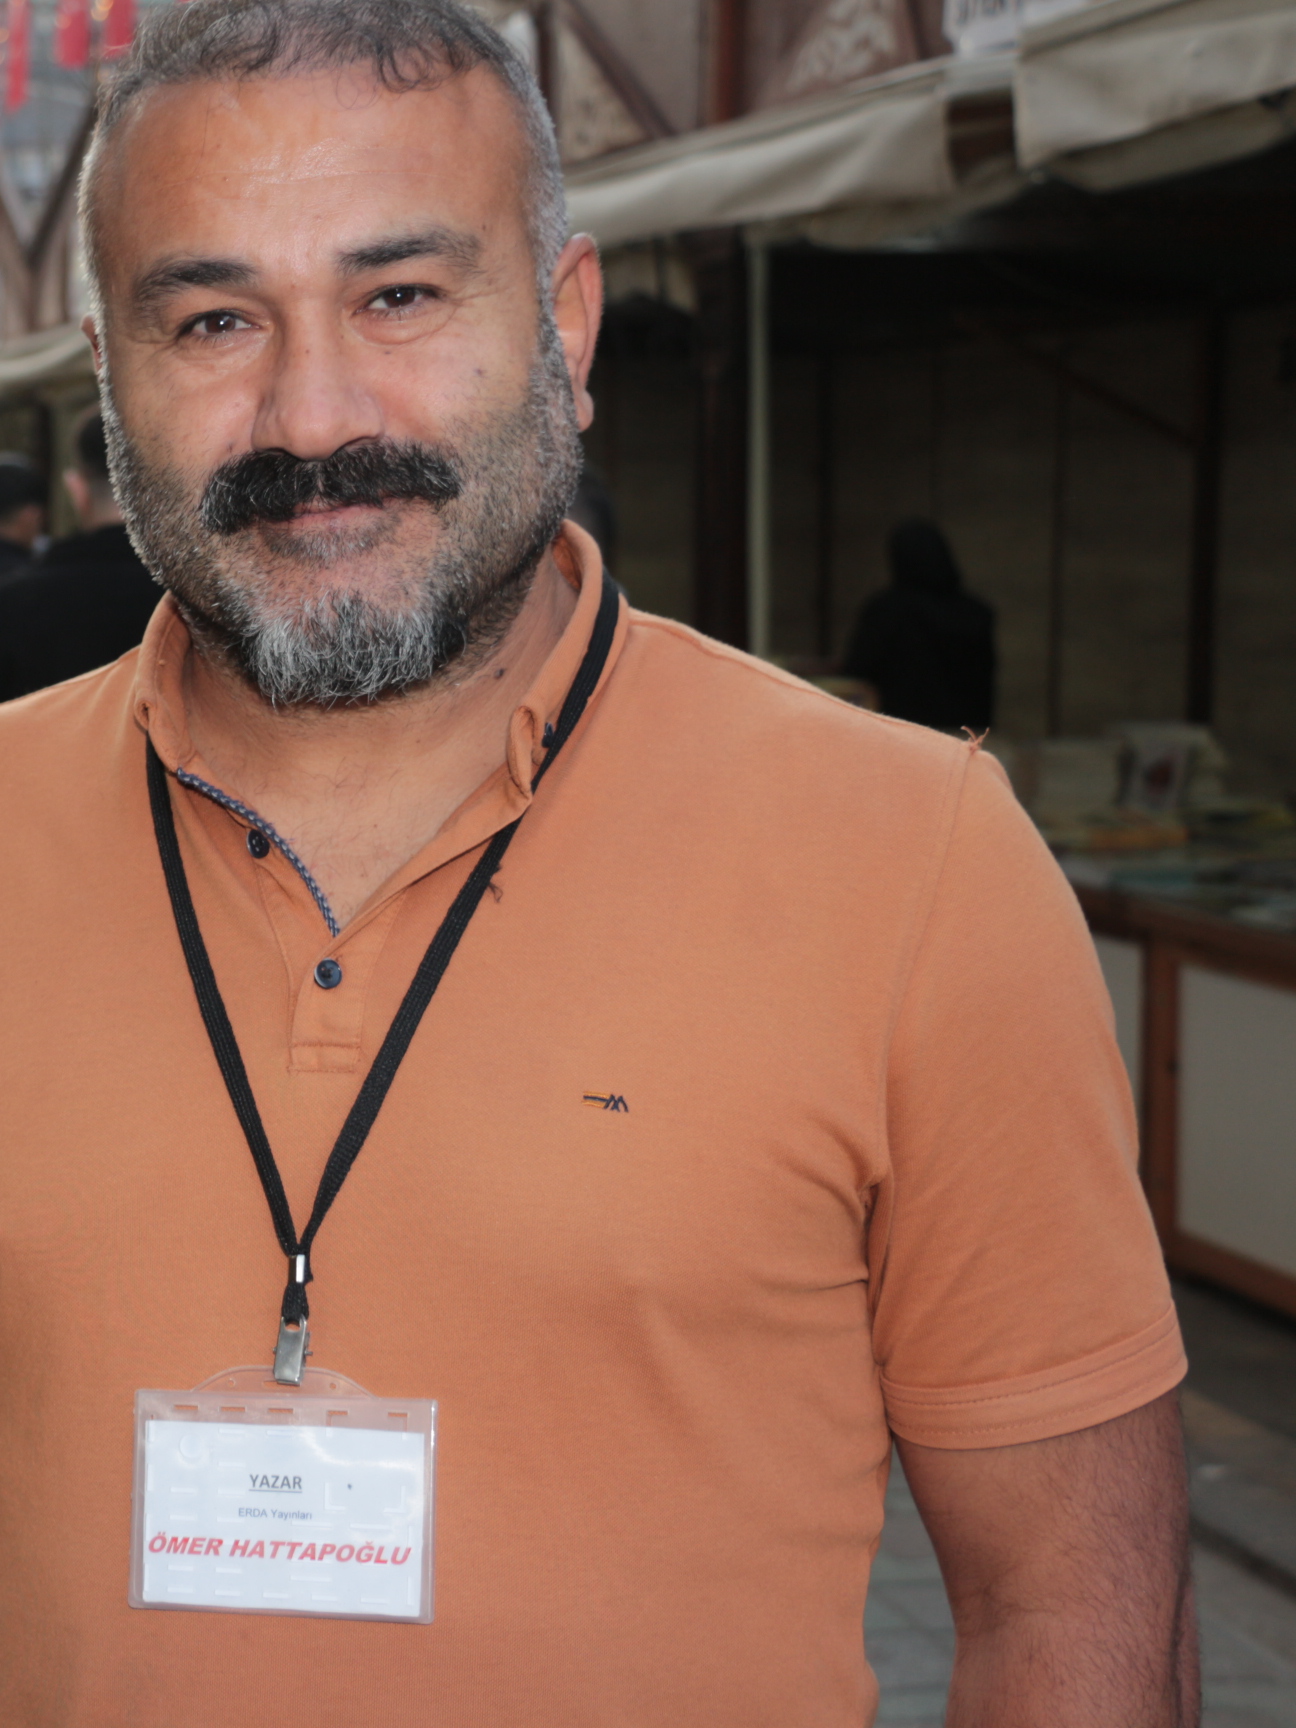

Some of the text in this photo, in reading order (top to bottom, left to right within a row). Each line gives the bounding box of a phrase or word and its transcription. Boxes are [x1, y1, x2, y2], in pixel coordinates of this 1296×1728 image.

[249, 1474, 302, 1490] YAZAR
[238, 1507, 313, 1520] ERDA Yayınları
[148, 1531, 412, 1565] ÖMER HATTAPOĞLU
